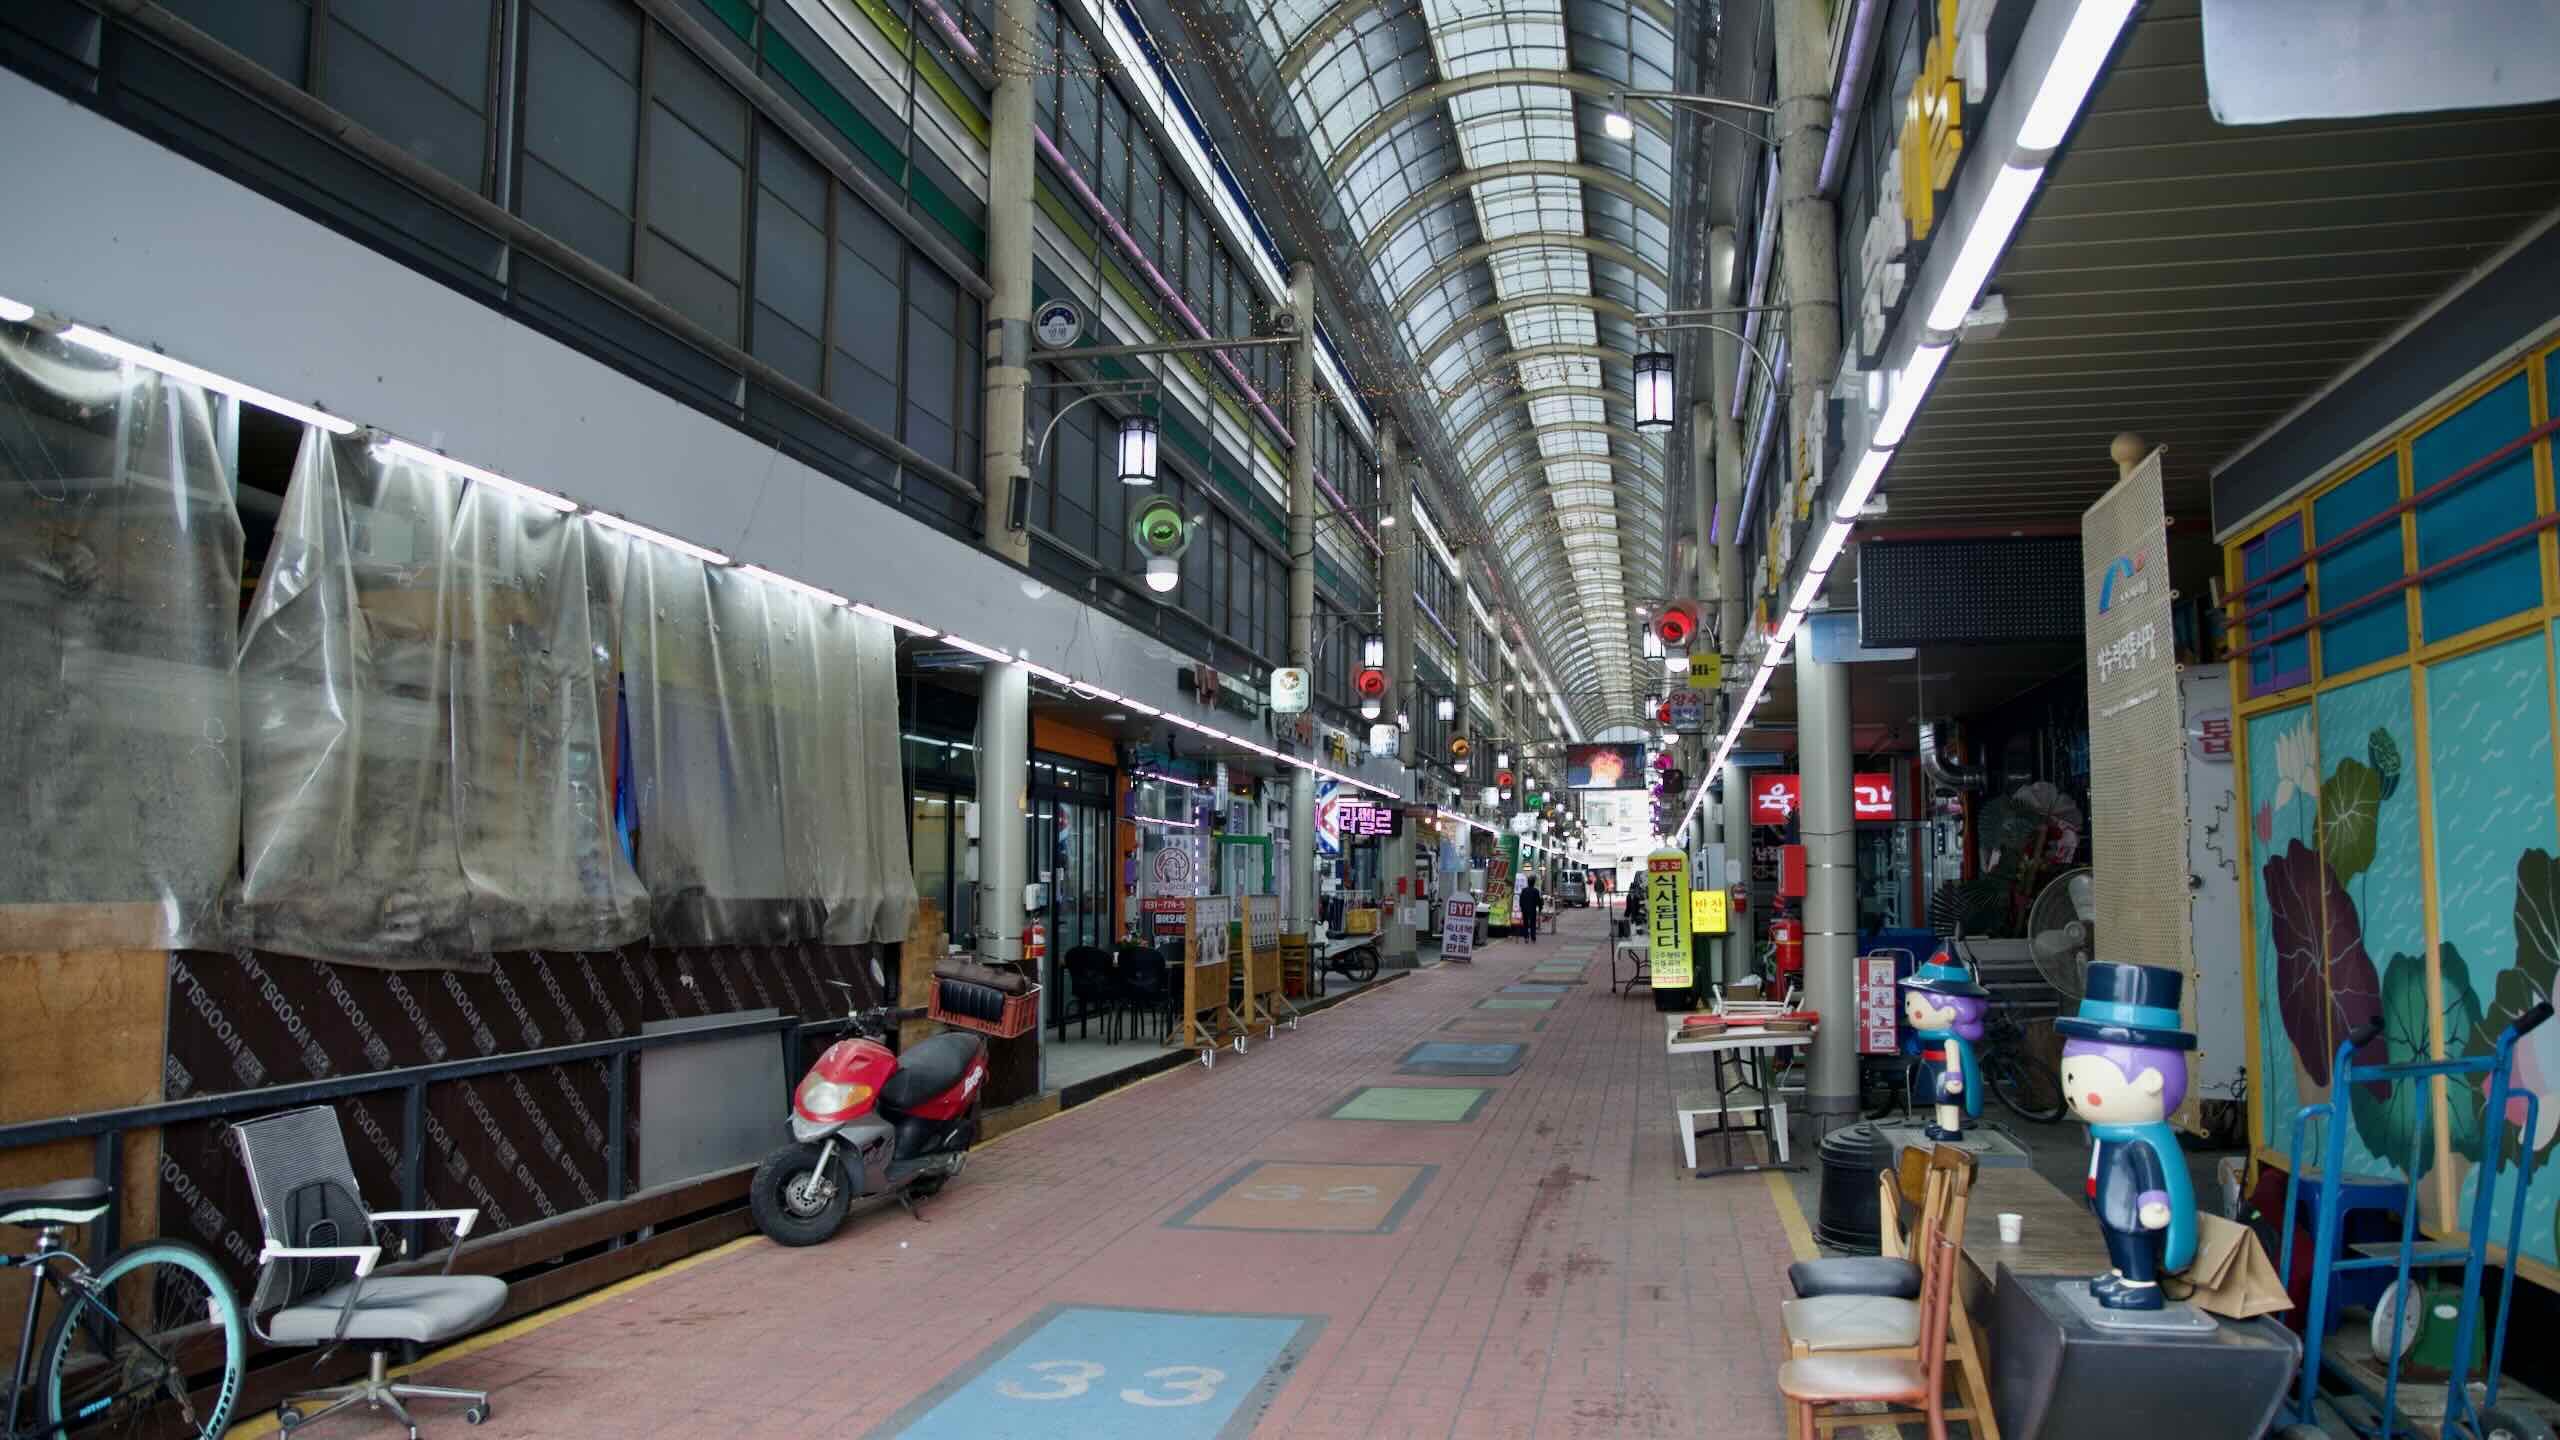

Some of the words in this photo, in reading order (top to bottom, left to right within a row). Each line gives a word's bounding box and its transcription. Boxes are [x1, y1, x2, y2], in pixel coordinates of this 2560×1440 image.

[1450, 902, 1473, 916] BYD
[1655, 874, 1681, 950] 식사됩니다
[995, 1359, 1226, 1408] 33
